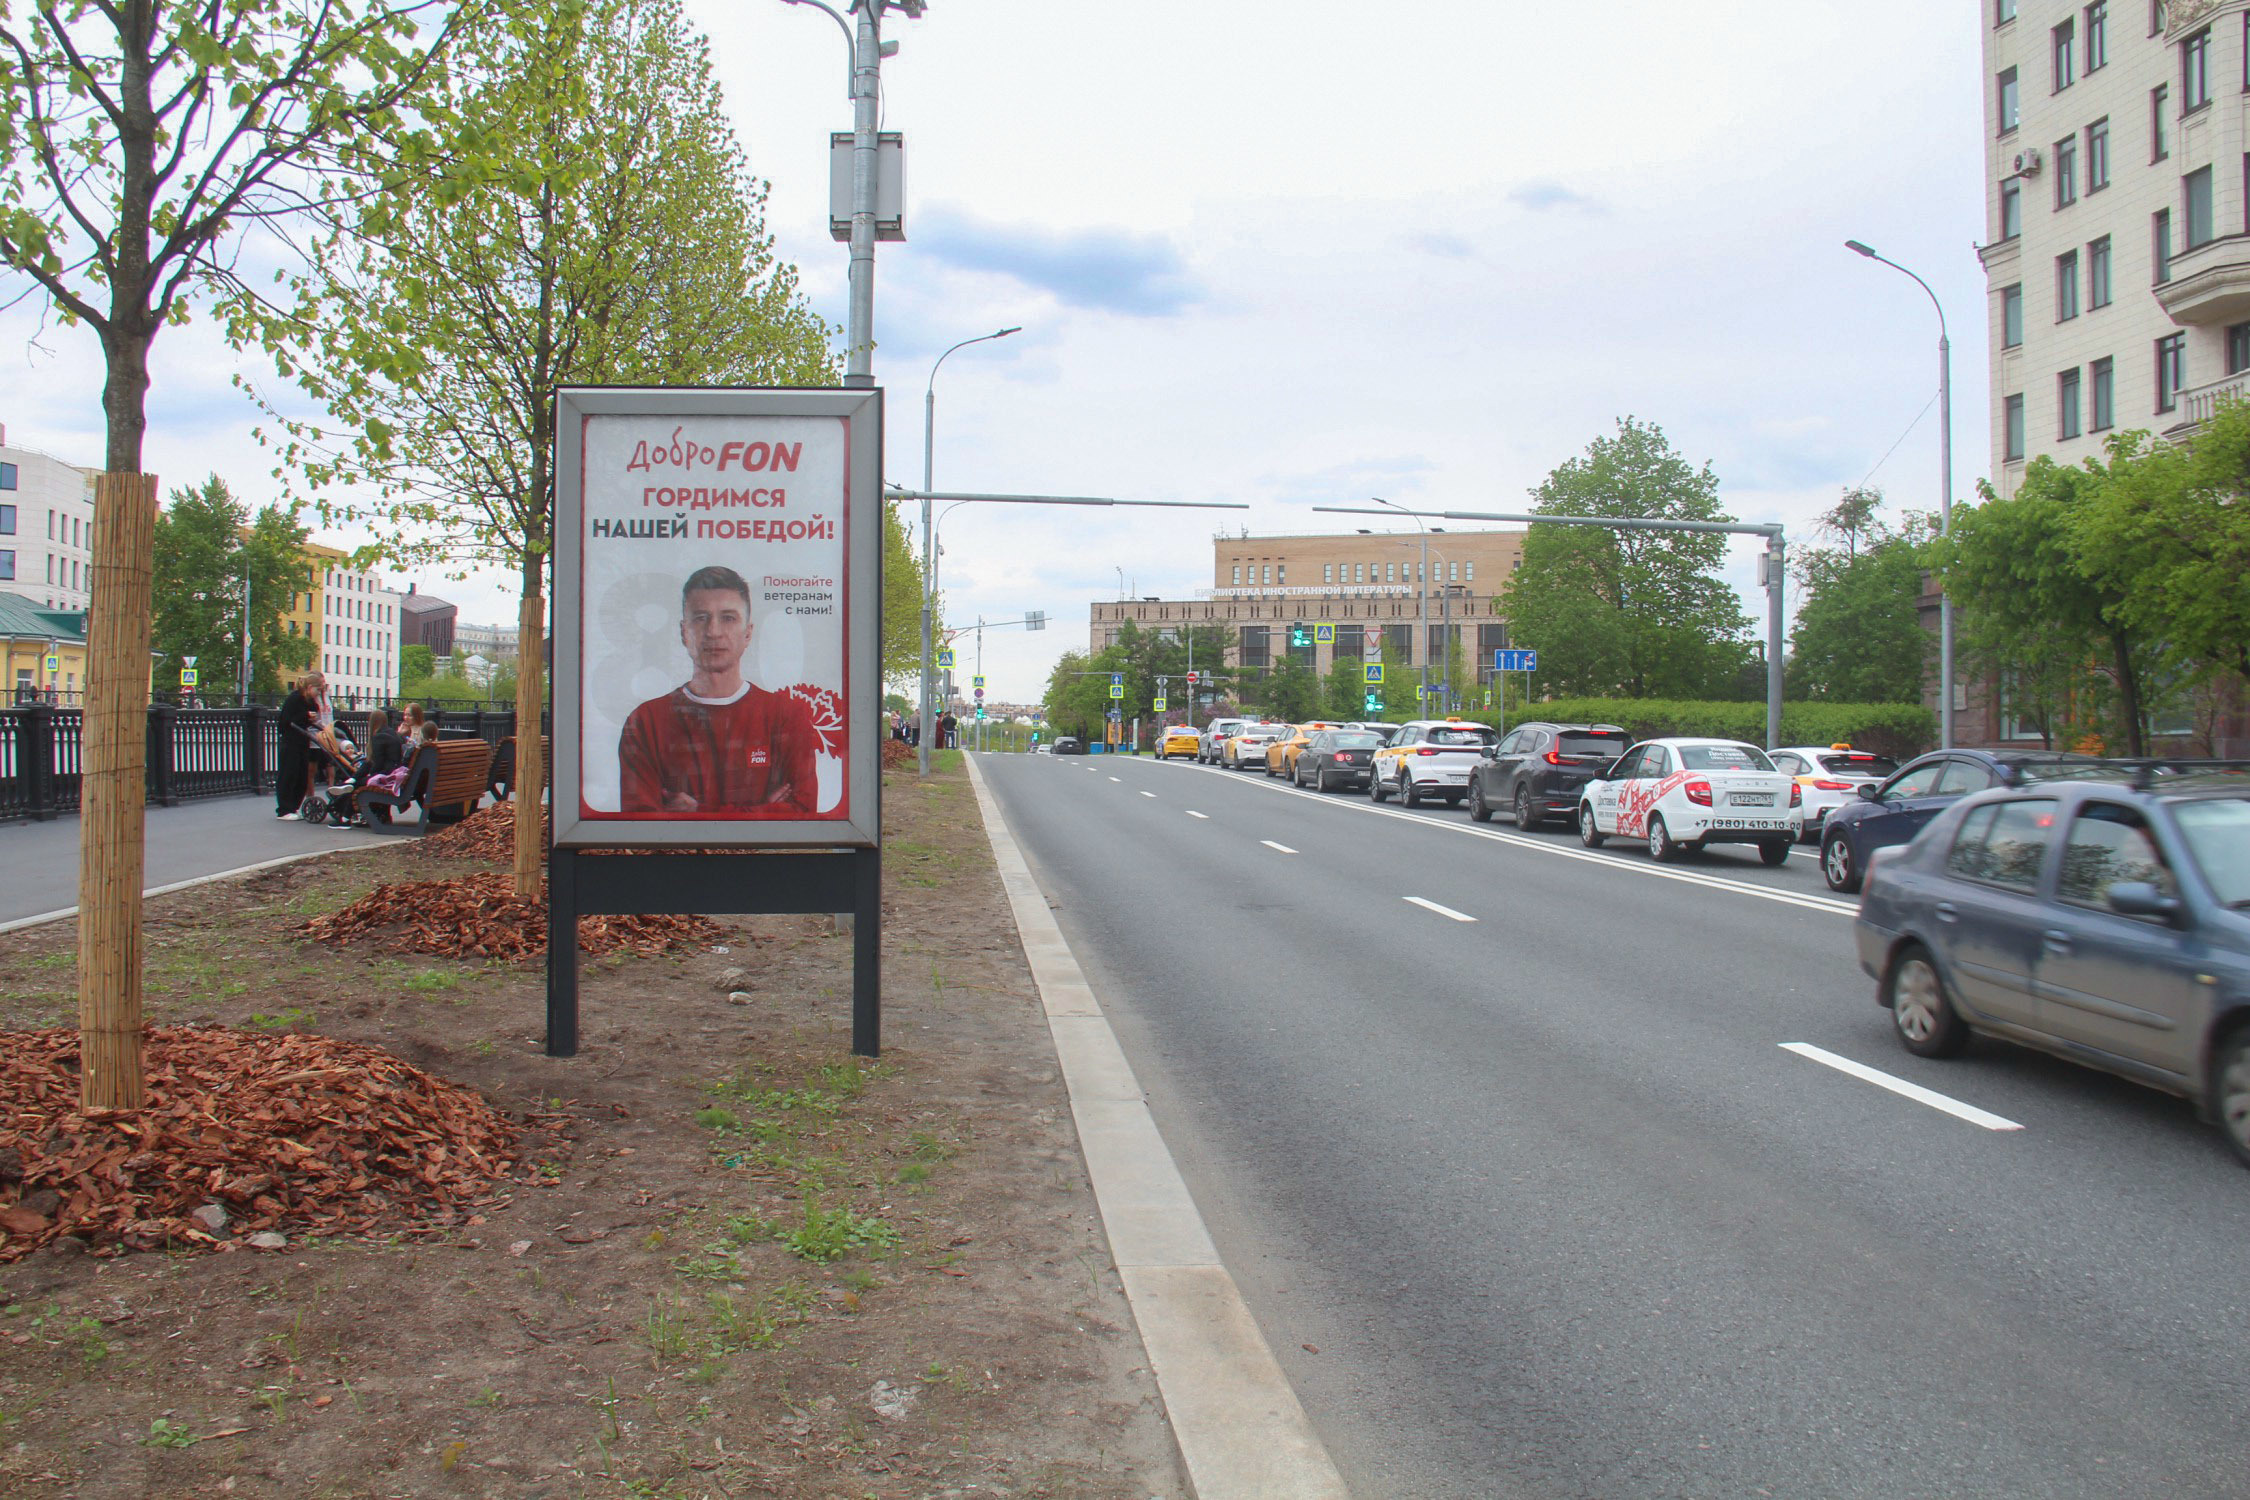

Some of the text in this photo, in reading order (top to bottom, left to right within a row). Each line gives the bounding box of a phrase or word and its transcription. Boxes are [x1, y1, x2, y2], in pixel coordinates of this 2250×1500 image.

[643, 487, 786, 511] ГОРДИМСЯ
[592, 512, 834, 543] НАШЕЙ ПОБЕДОЙ!
[763, 575, 833, 589] Помогайте
[1263, 584, 1340, 596] ИНОСТРАННОЙ
[1343, 585, 1413, 595] ЛИТЕРАТУРЫ
[763, 591, 833, 603] ветеранам
[785, 605, 832, 615] с нами!
[1695, 818, 1801, 830] +7 (980) 410-10-00
